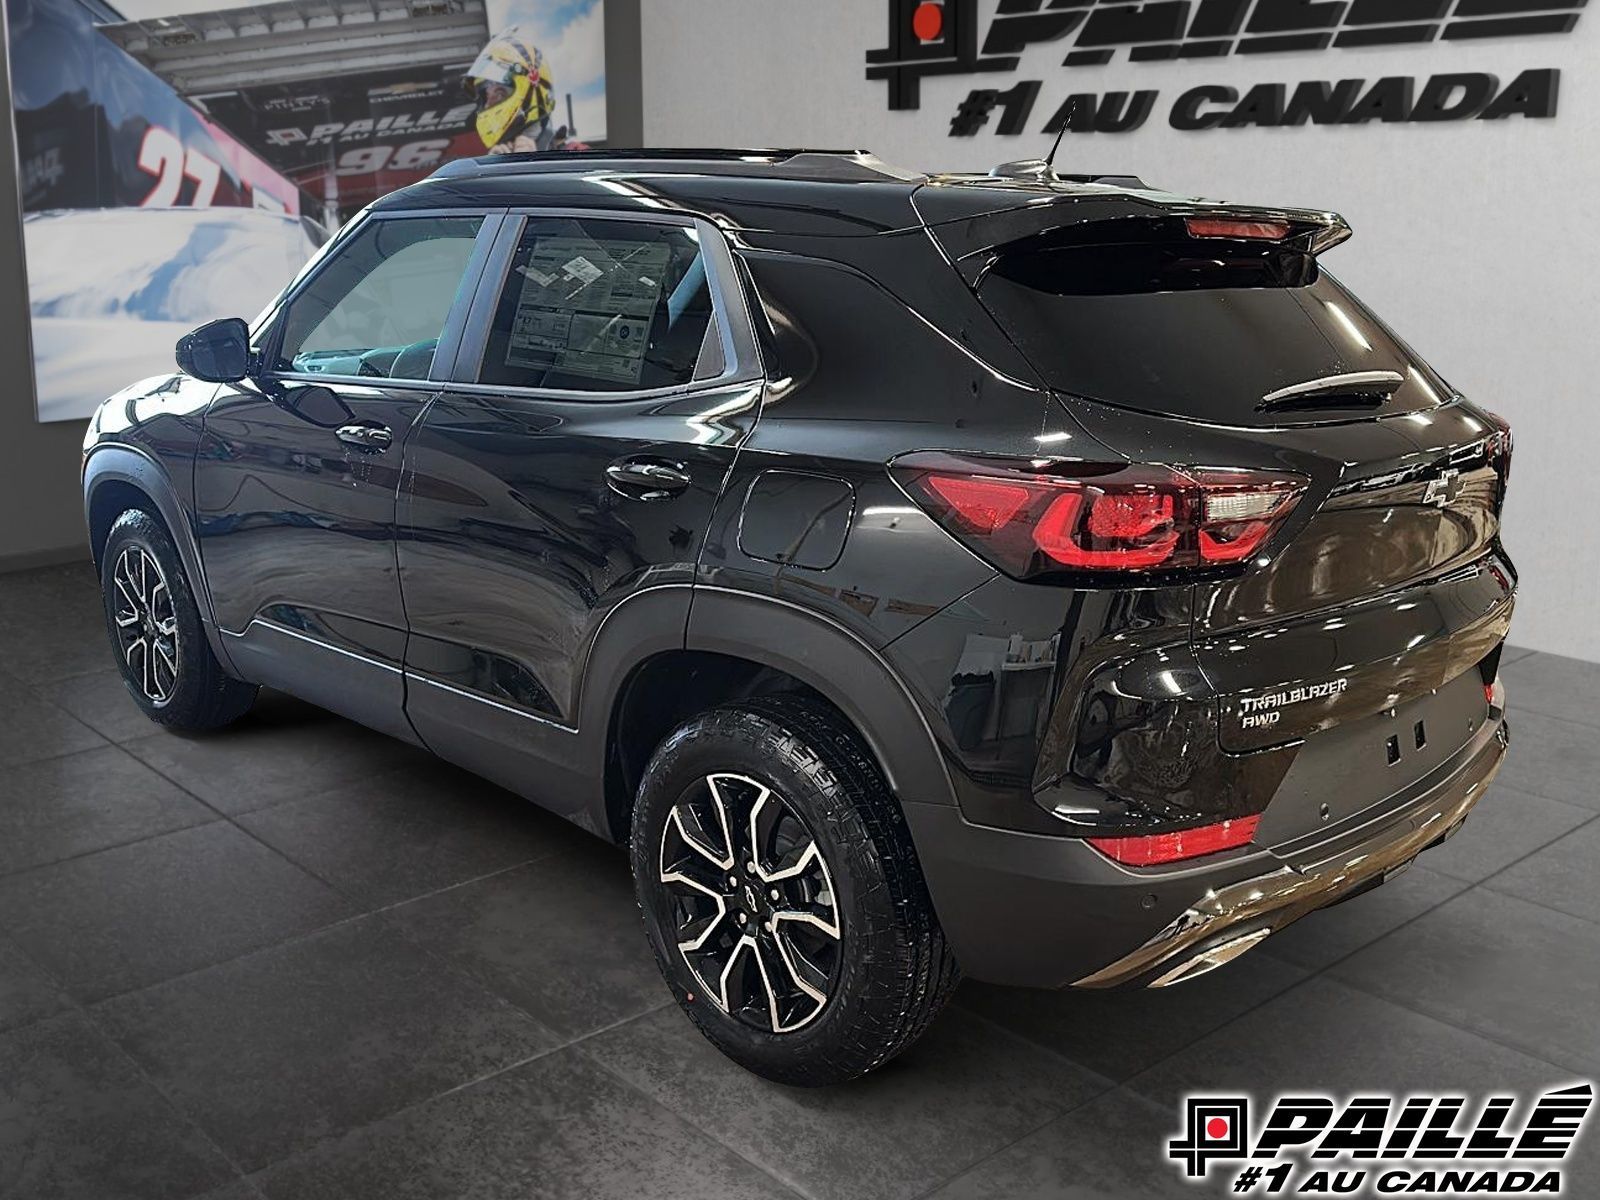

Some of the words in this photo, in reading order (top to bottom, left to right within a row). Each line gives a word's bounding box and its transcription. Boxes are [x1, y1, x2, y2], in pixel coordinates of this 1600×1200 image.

[948, 80, 1043, 136] #1
[1041, 90, 1159, 134] AU
[1168, 68, 1561, 132] CANADA
[336, 138, 451, 176] 96
[1240, 677, 1348, 713] TRAILBLAZER
[1241, 711, 1281, 729] AWD
